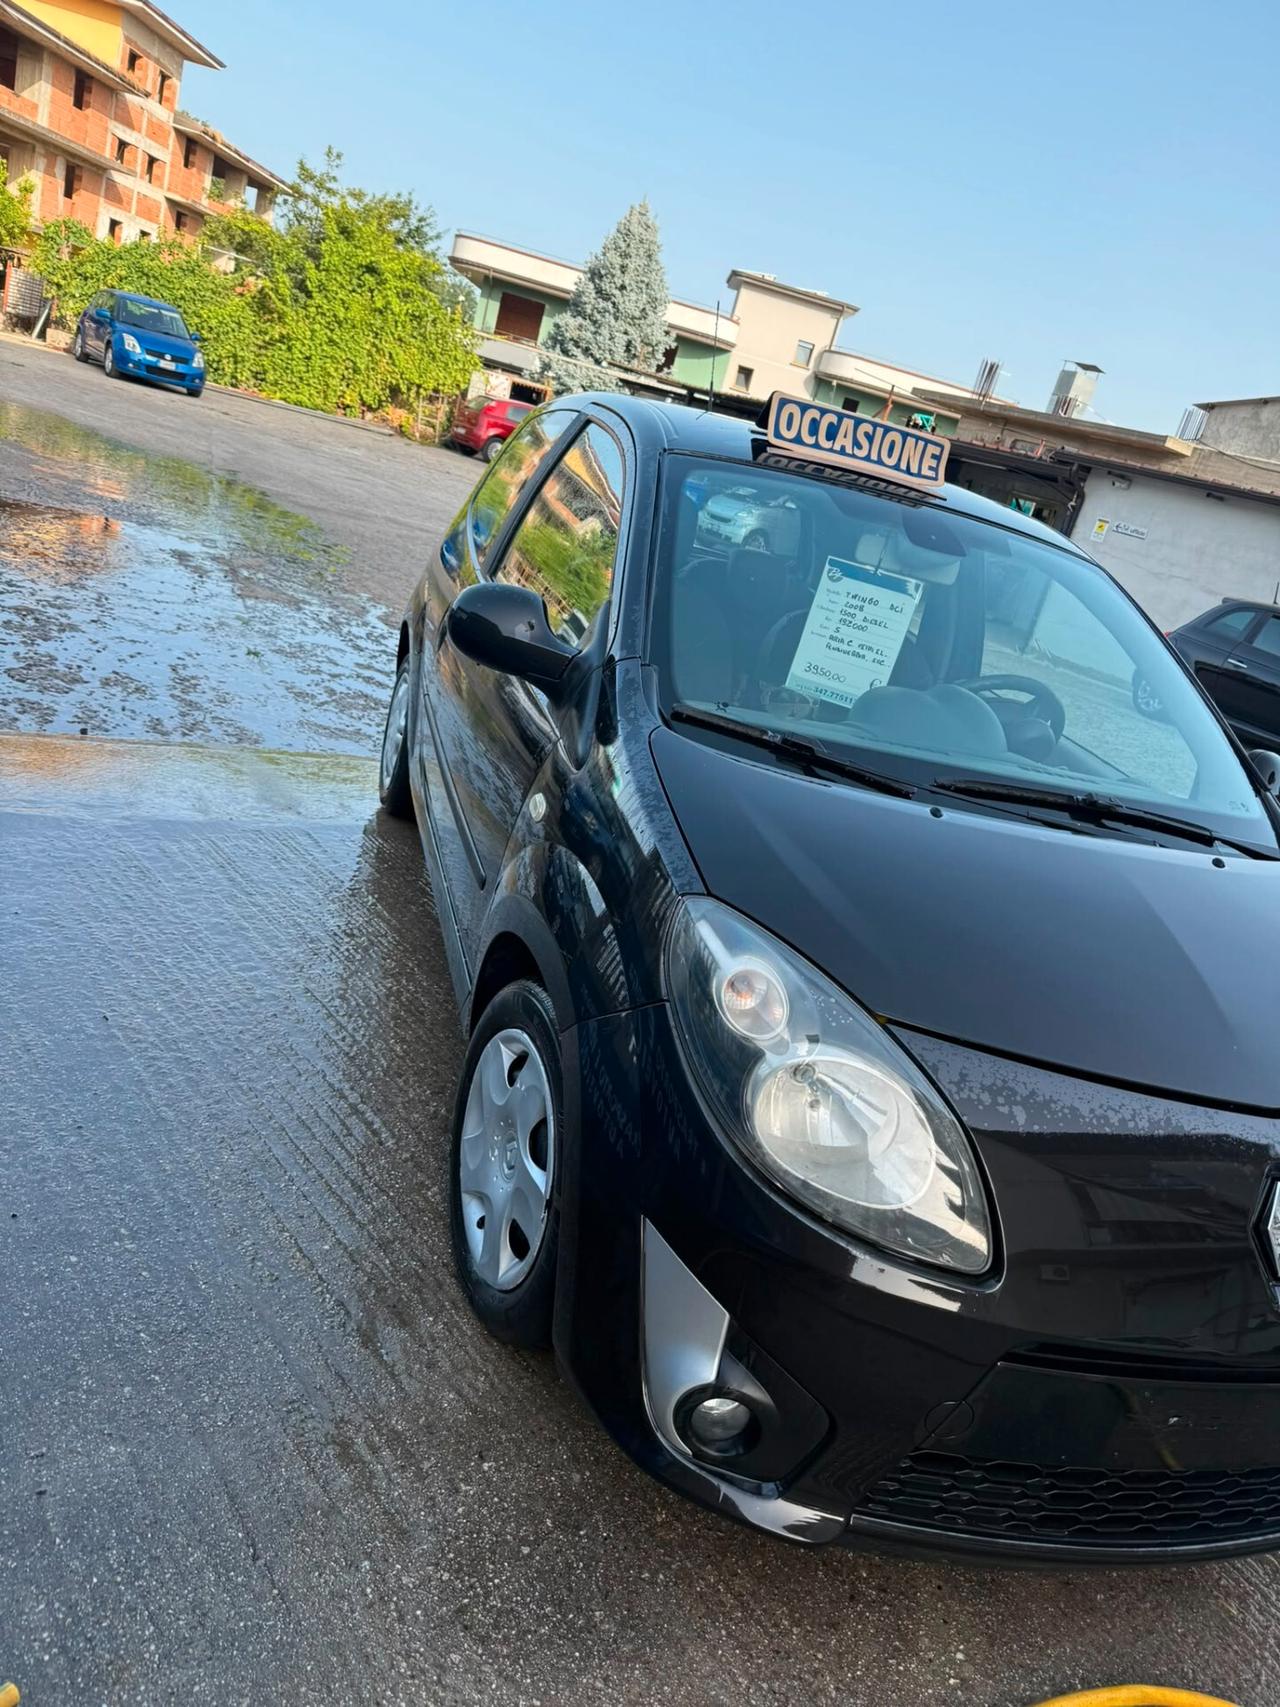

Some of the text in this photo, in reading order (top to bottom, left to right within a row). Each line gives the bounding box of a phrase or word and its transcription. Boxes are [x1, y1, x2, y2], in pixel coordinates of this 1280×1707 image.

[778, 403, 941, 478] OCCASIONE
[846, 591, 879, 606] TWINGO
[844, 602, 865, 612] 2008
